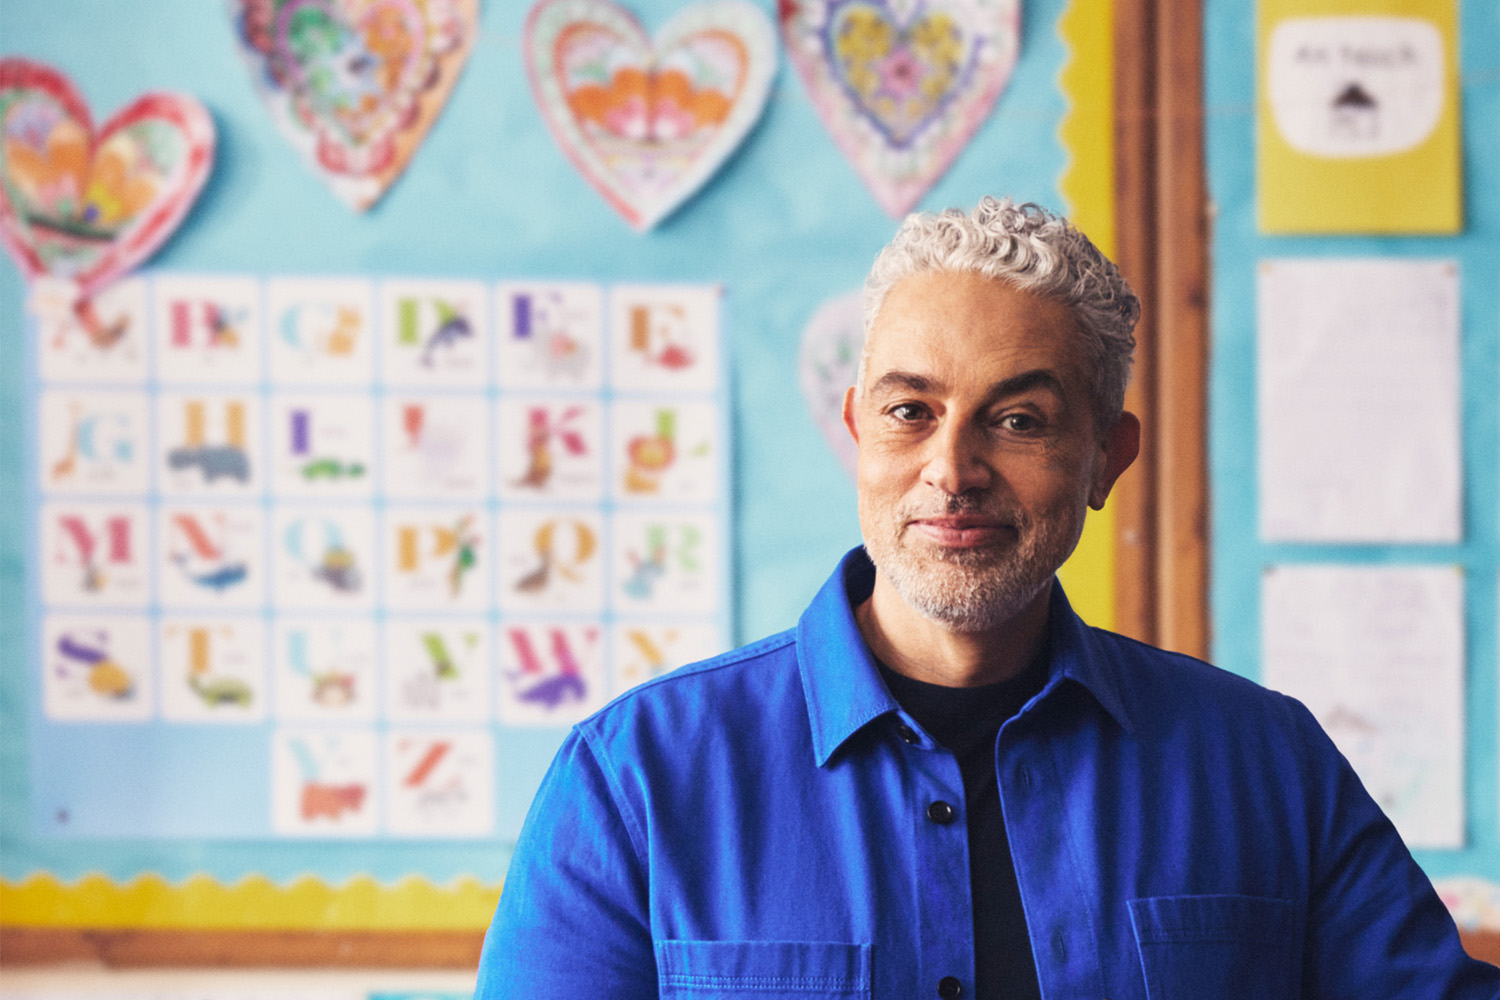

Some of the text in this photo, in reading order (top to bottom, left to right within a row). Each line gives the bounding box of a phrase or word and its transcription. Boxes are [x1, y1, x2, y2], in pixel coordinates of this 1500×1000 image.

[527, 405, 588, 456] K
[58, 516, 131, 563] M
[398, 524, 458, 571] P
[508, 626, 600, 675] W
